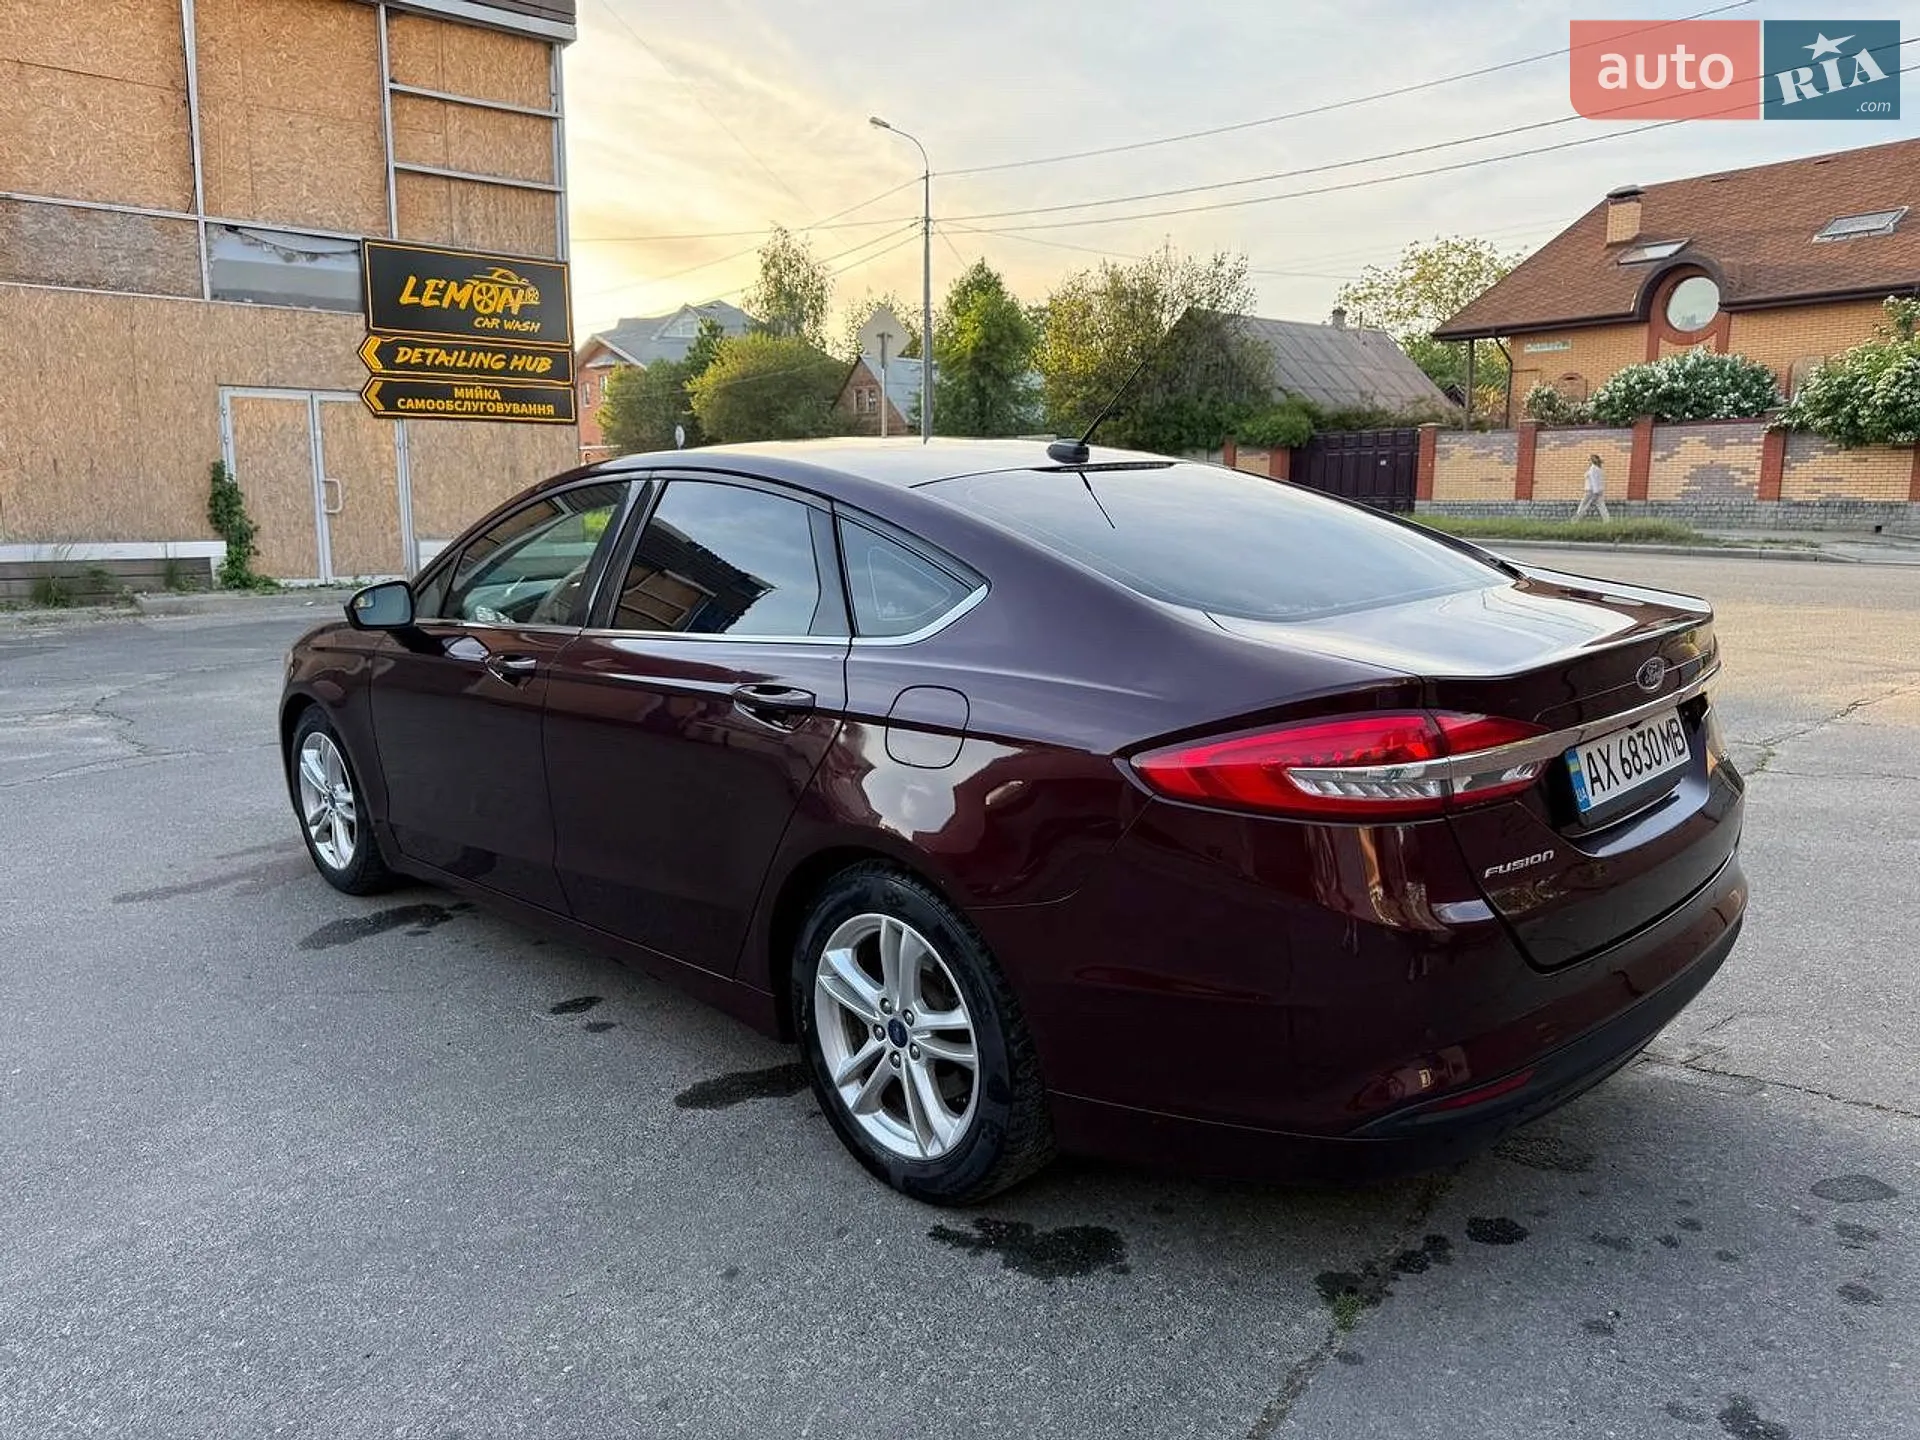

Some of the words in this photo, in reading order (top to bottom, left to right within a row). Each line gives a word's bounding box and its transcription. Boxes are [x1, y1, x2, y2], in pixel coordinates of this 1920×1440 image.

[399, 275, 523, 315] LEMON
[473, 317, 499, 329] CAR
[503, 319, 541, 333] WASH
[395, 347, 507, 370] DETAILING
[509, 354, 553, 373] HUB
[454, 386, 501, 400] МИЙКА
[397, 398, 555, 416] САМООБСЛУГОВУВАННЯ
[1586, 744, 1620, 796] AX
[1619, 727, 1662, 781] 6830
[1661, 717, 1687, 762] MB
[1484, 850, 1554, 879] FUSION
